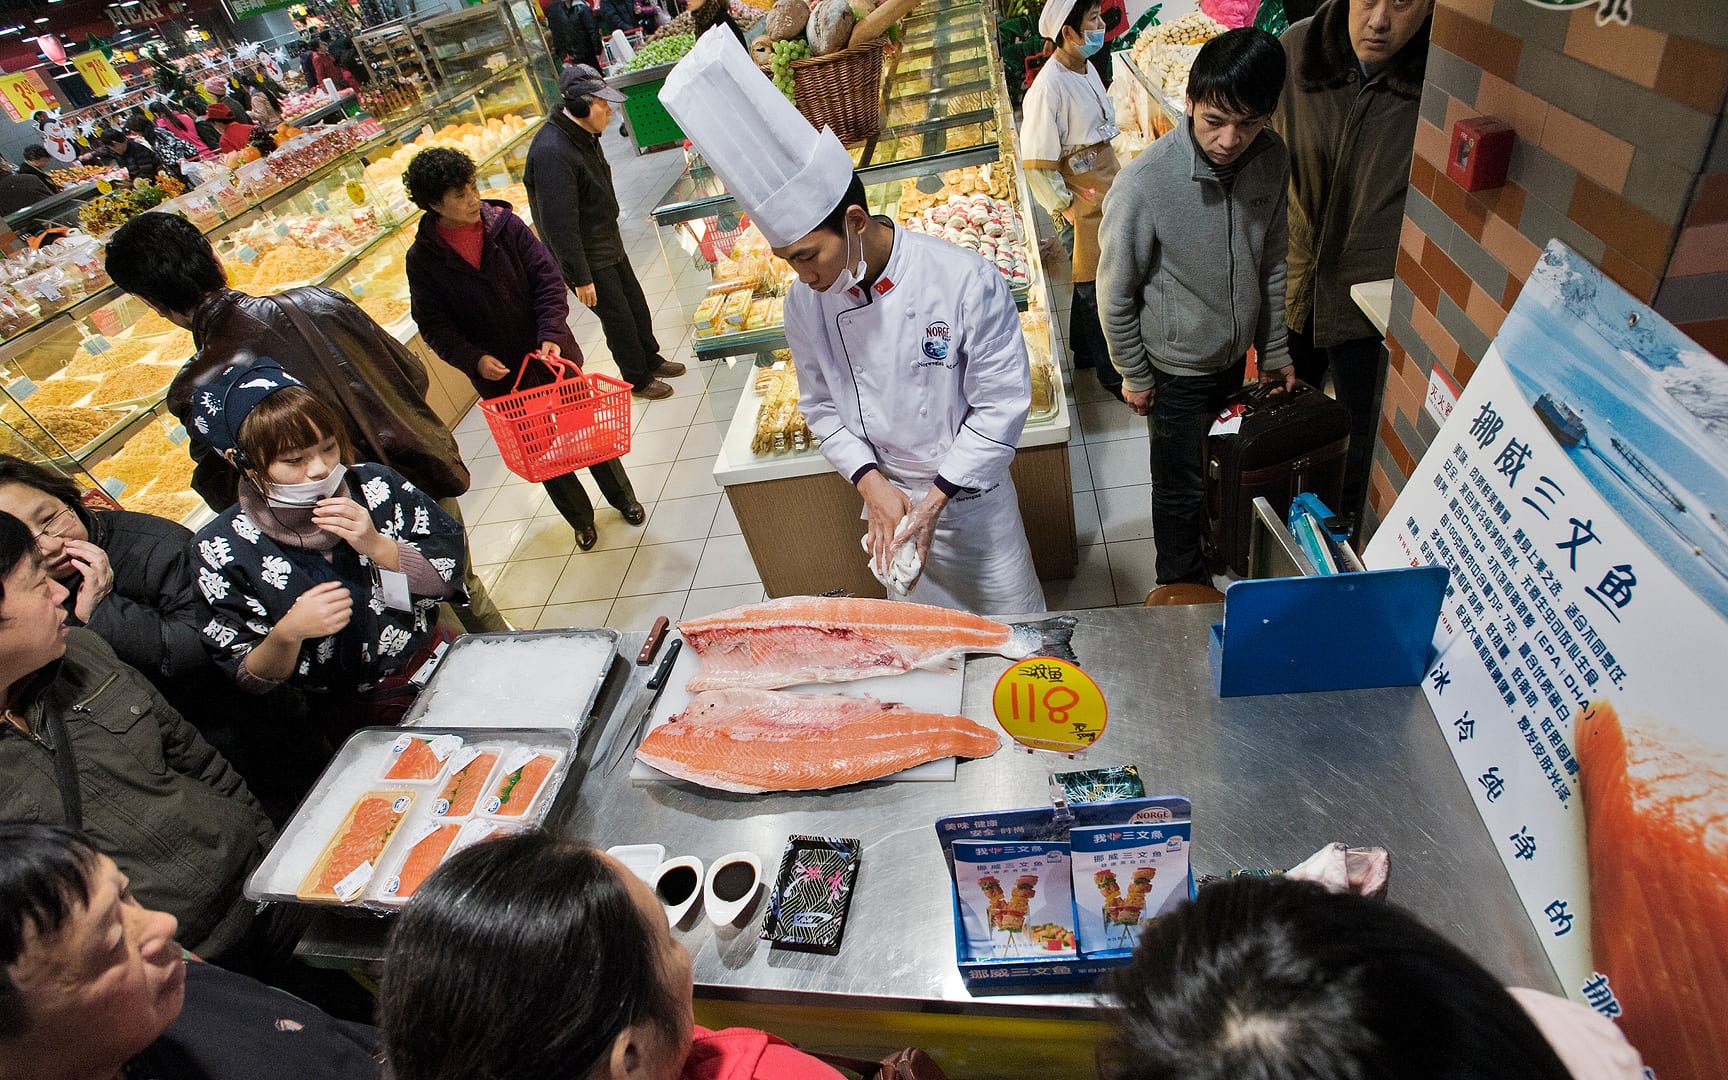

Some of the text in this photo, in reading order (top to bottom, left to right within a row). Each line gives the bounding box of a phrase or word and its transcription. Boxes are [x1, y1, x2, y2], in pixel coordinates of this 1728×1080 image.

[104, 0, 164, 28] MEAT
[925, 326, 950, 338] NORGE
[1468, 401, 1638, 623] 挪威三文鱼
[1011, 682, 1080, 724] 118
[1136, 811, 1170, 820] NORGE
